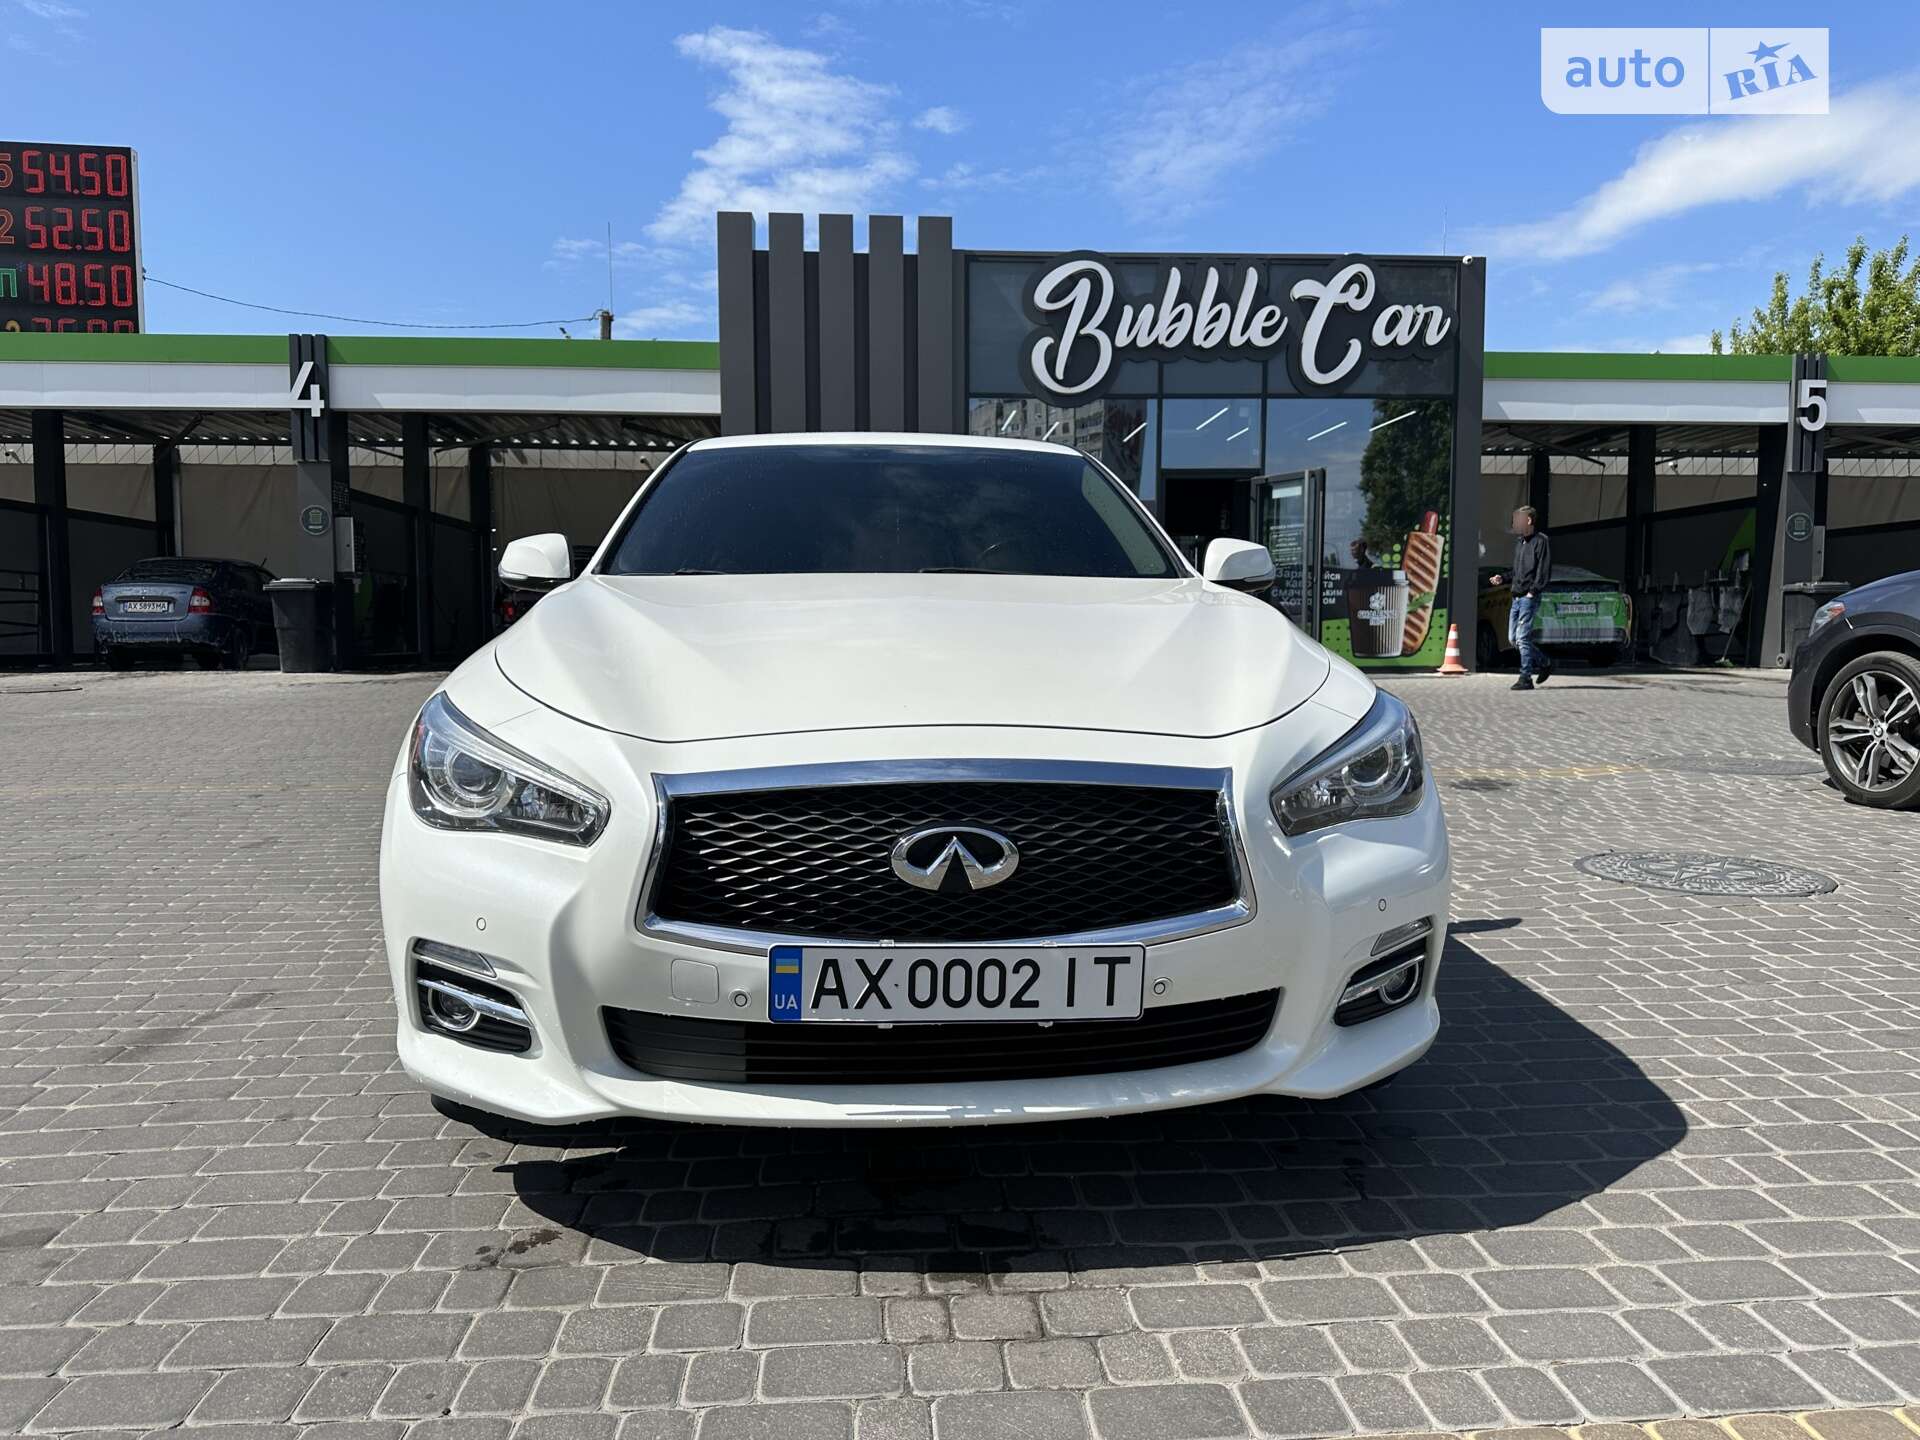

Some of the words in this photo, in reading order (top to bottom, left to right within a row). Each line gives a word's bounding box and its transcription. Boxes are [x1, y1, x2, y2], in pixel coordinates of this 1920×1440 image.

[22, 150, 128, 197] 54.50
[25, 206, 131, 252] 52.50
[27, 263, 133, 307] 48.50
[1031, 260, 1288, 394] Bubble
[1290, 263, 1451, 385] Car
[289, 361, 325, 418] 4
[1797, 379, 1828, 432] 5
[774, 994, 799, 1010] UA
[810, 958, 894, 1010] AX
[908, 958, 1041, 1009] 0002
